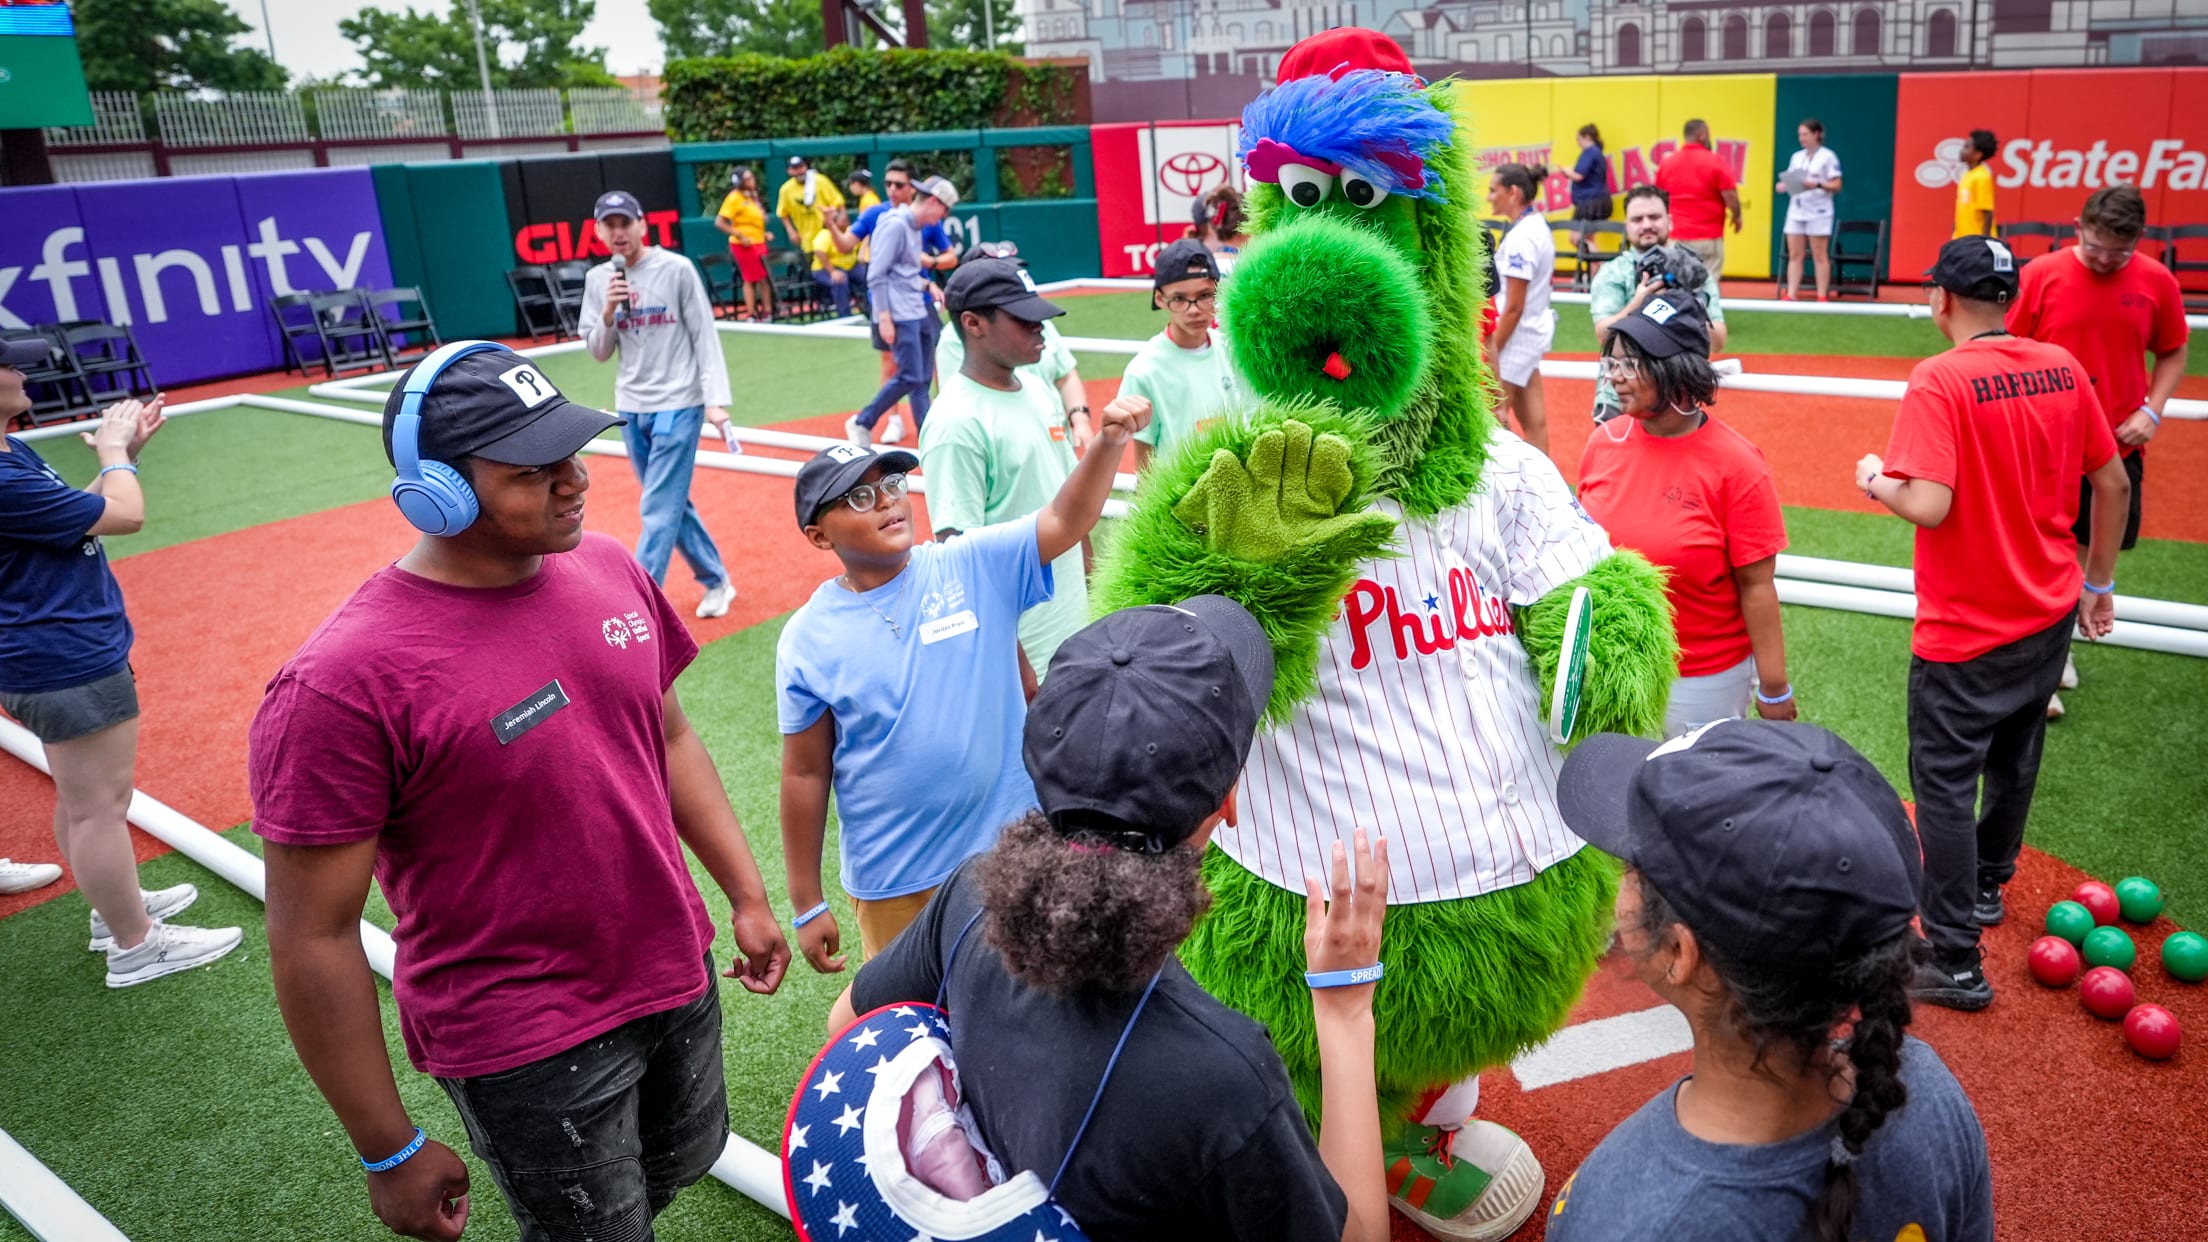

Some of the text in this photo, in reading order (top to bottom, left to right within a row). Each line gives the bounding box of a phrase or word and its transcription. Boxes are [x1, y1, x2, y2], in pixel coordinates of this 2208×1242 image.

[2140, 138, 2208, 190] Fa
[515, 210, 679, 264] GIAT
[1971, 366, 2075, 403] HARDING
[505, 693, 556, 730] Jeremiah Lincoln
[1350, 968, 1381, 983] SPREAD
